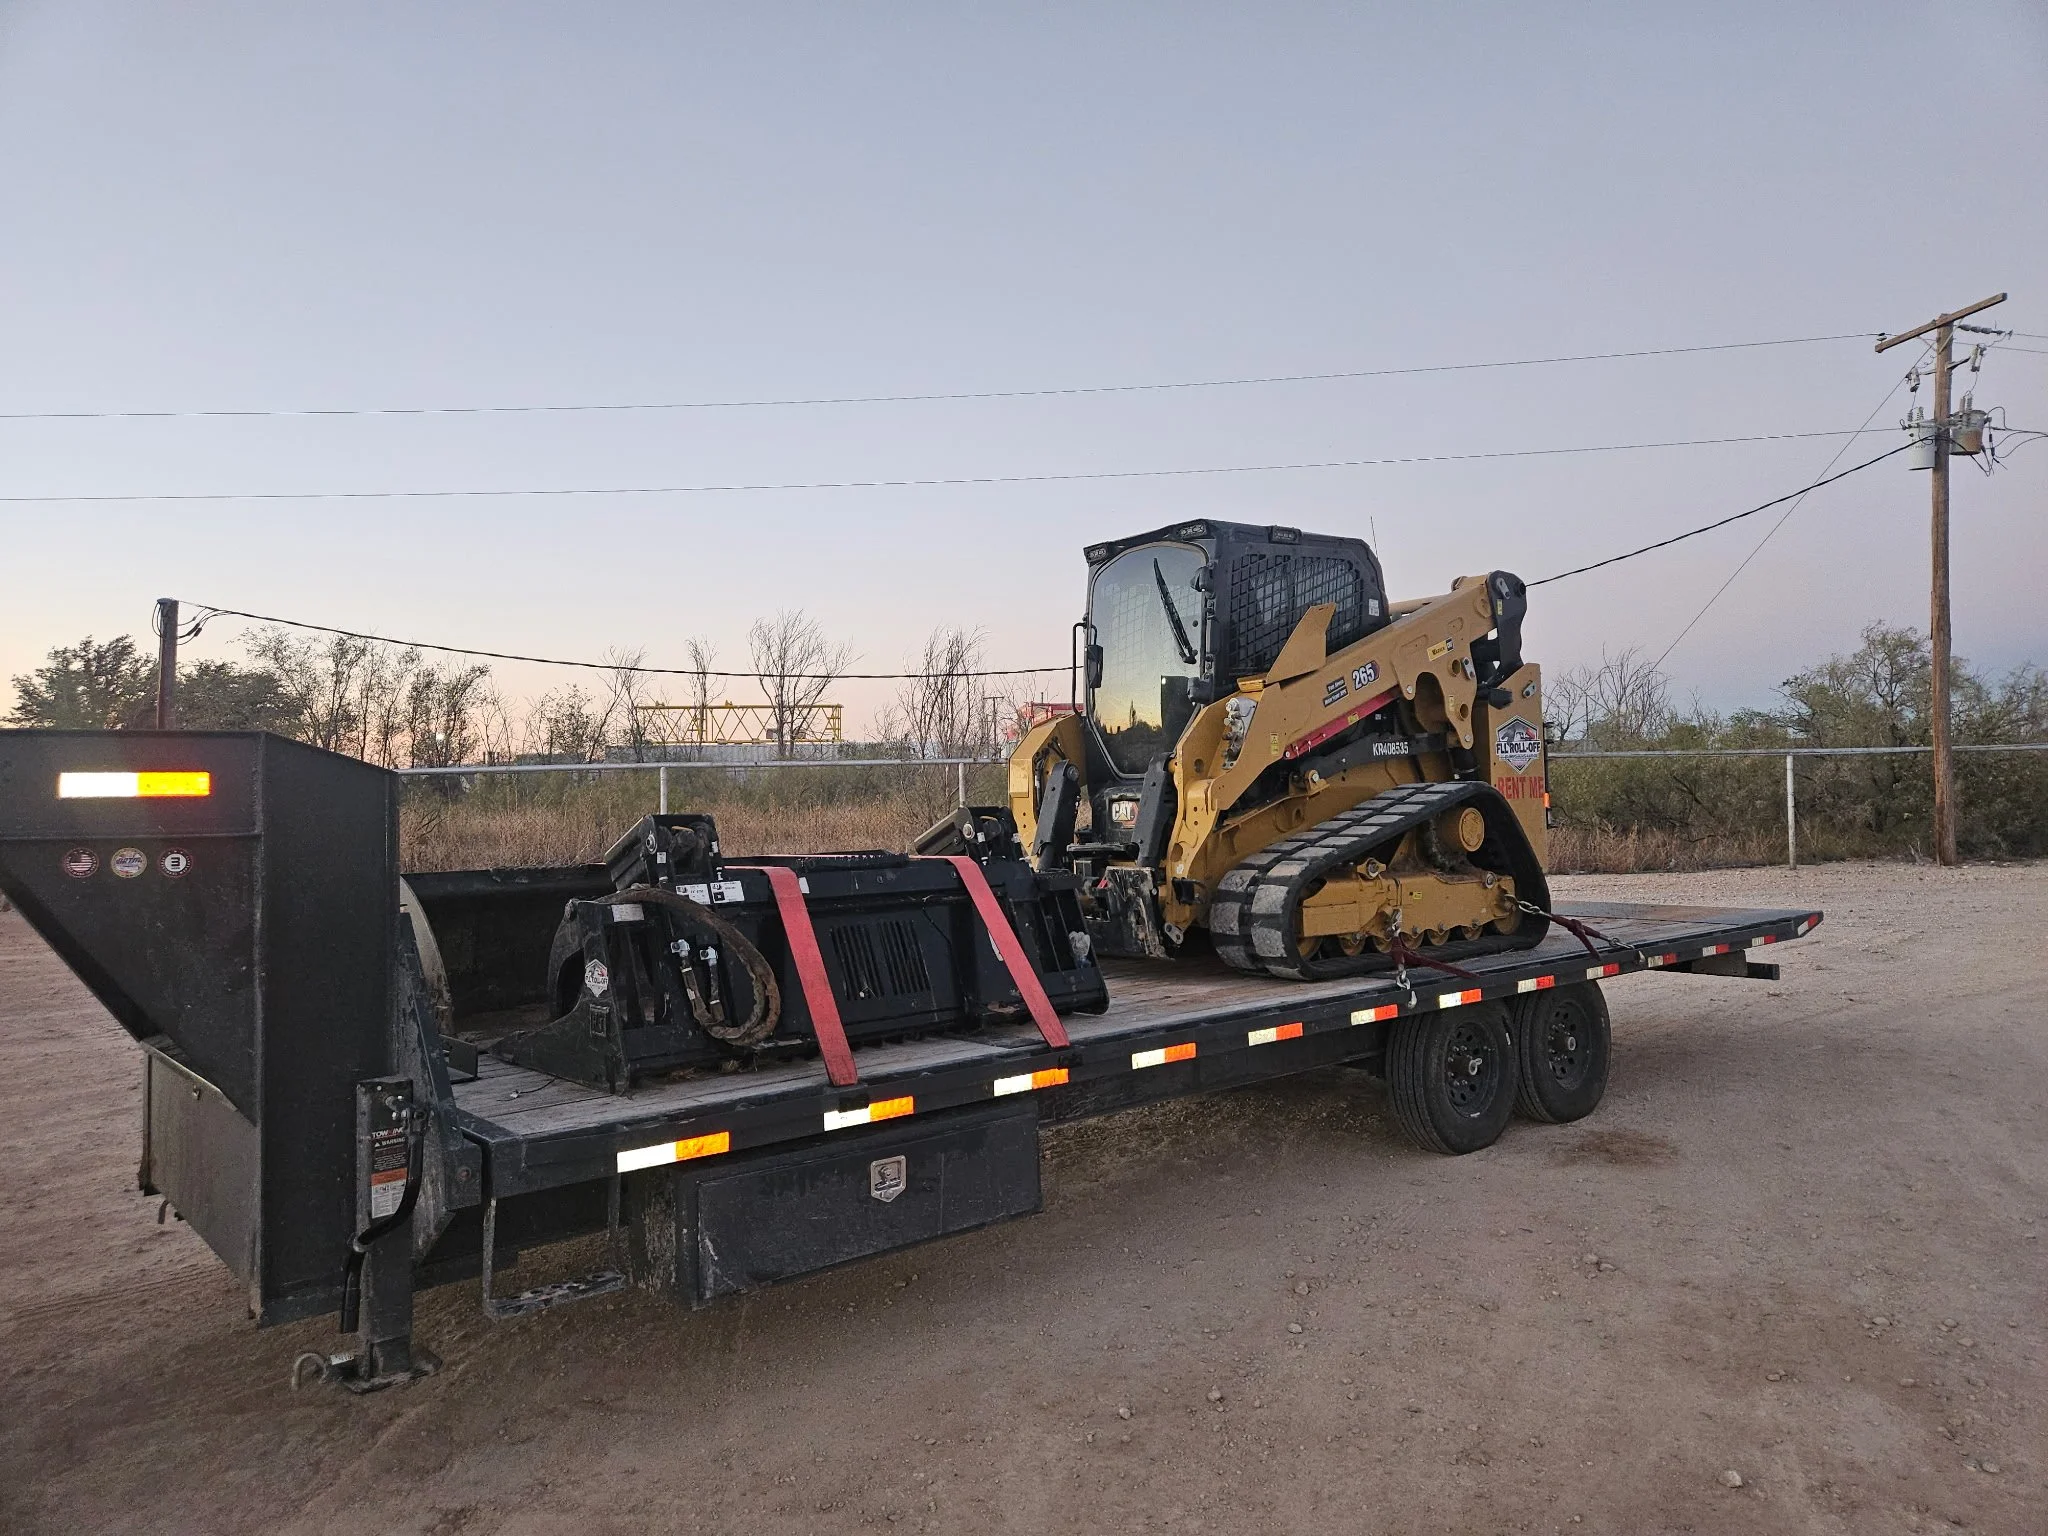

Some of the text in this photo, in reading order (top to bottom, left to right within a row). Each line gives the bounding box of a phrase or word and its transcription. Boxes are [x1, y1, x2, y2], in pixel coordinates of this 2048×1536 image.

[1352, 663, 1375, 690] 265
[1372, 741, 1409, 756] KR408535
[1509, 741, 1541, 754] ROLL-OFF
[1497, 776, 1544, 799] RENT ME
[1111, 800, 1133, 821] CAT
